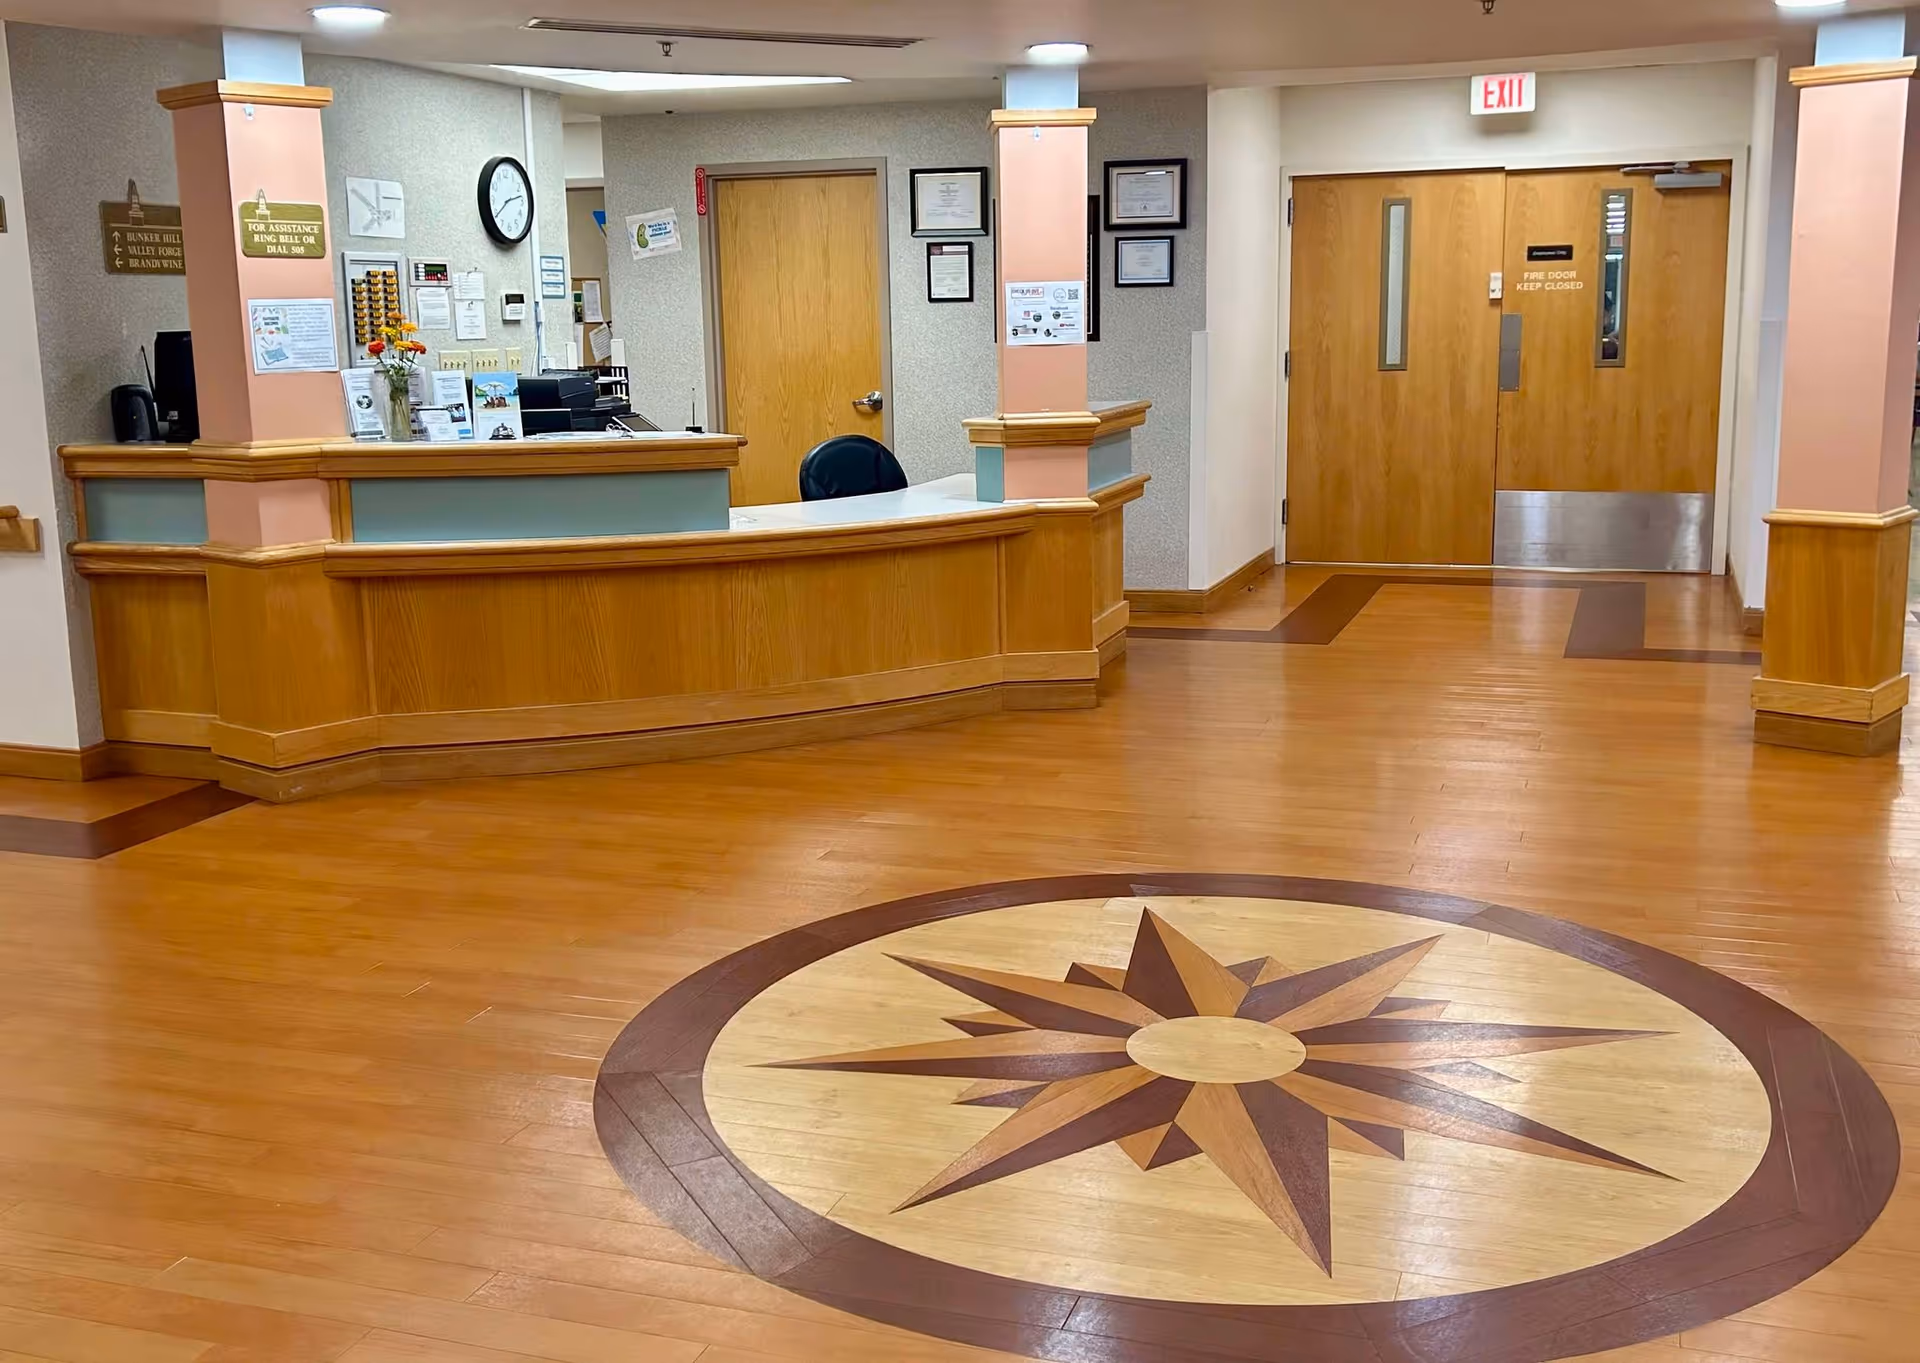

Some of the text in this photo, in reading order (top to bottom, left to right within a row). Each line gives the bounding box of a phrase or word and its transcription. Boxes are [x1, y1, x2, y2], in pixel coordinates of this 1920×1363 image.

[1483, 78, 1524, 109] EXIT
[247, 223, 319, 233] FOR ASSISTANCE
[126, 232, 182, 244] BUNKER HILL
[253, 233, 316, 244] RING BELL OR
[127, 245, 182, 257] VALLEY FORGE
[266, 245, 289, 254] DIAL
[128, 258, 184, 269] BRANDYWINE
[1523, 270, 1577, 280] FIRE DOOR
[1516, 281, 1584, 291] KEEP CLOSED
